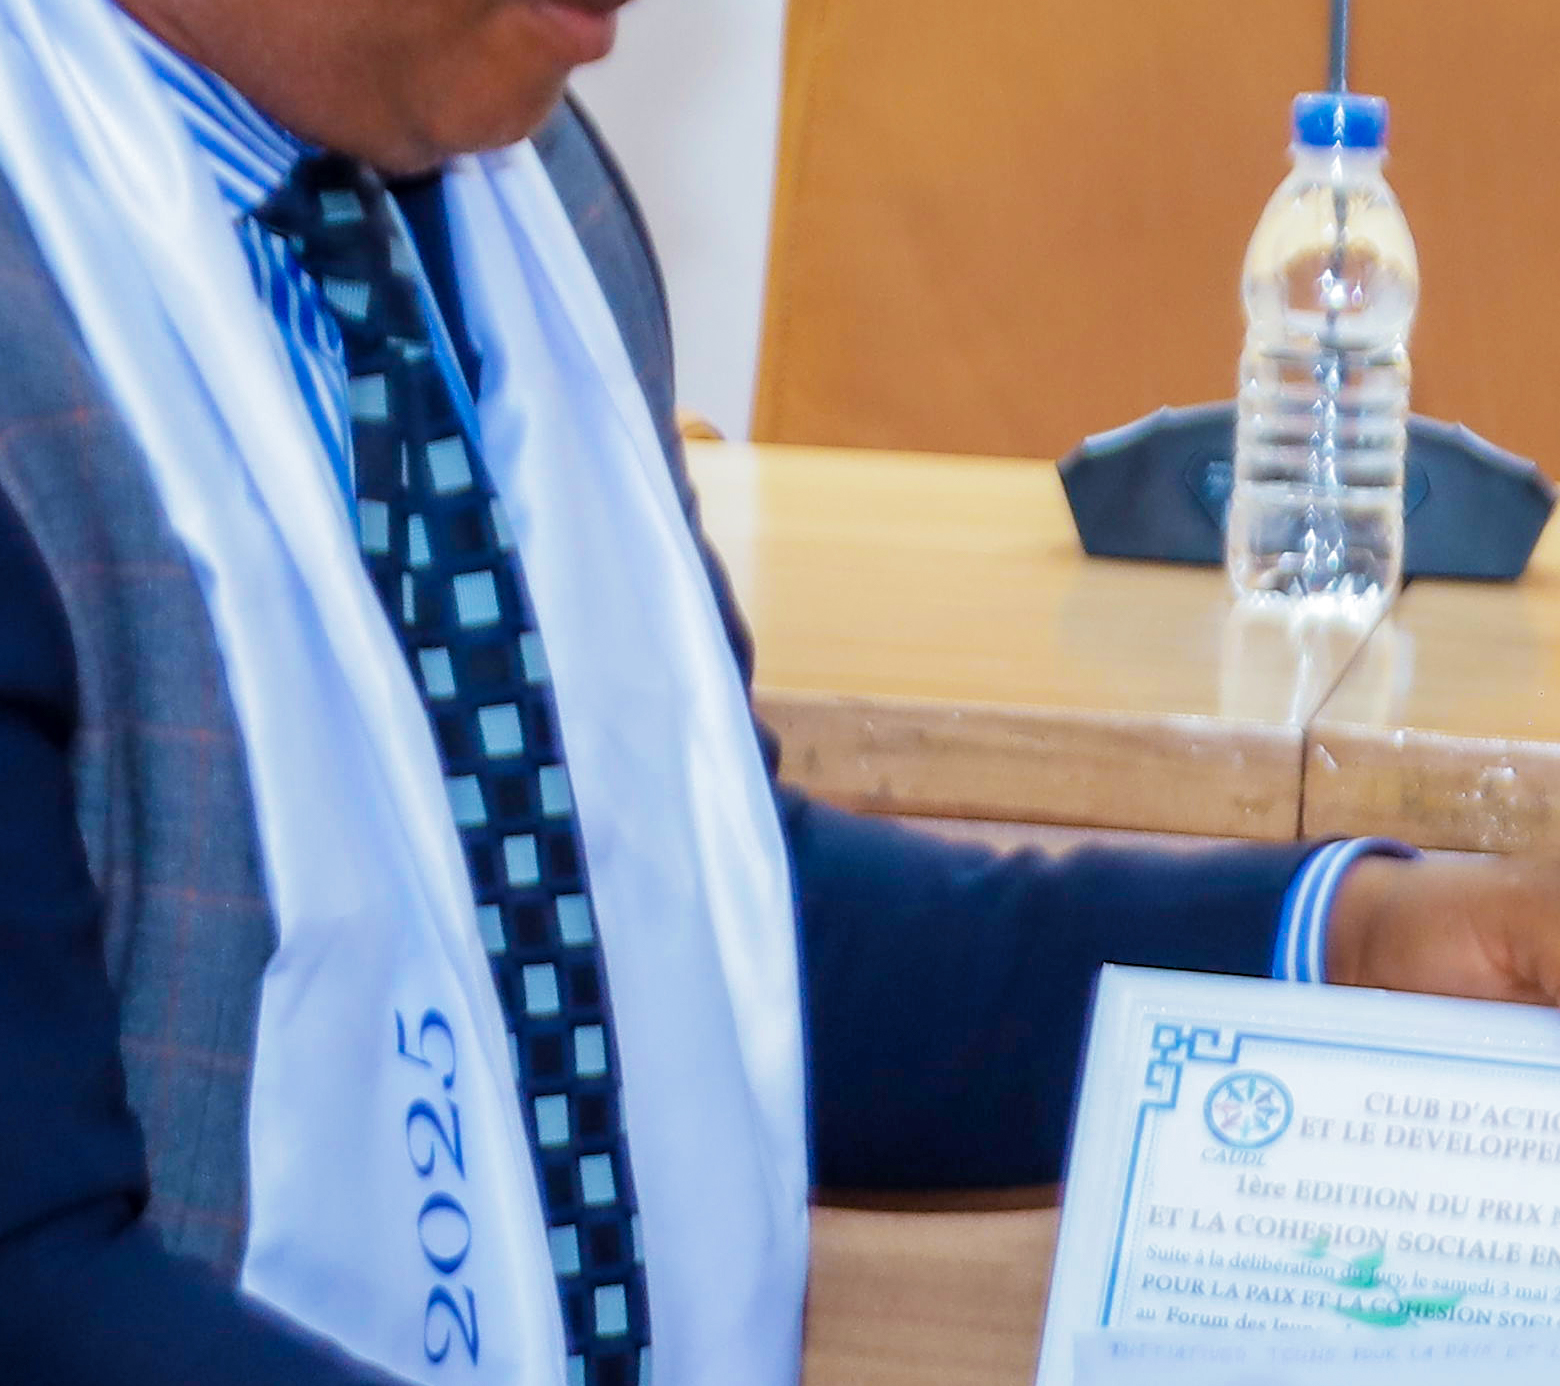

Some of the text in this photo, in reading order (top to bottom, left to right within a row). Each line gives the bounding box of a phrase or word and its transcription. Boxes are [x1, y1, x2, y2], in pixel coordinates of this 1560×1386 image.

[1299, 1116, 1333, 1140] ET
[1342, 1120, 1377, 1144] LE
[1364, 1091, 1441, 1120] CLUB
[1201, 1147, 1267, 1167] CAUDL
[395, 1007, 480, 1366] 2025
[1235, 1174, 1286, 1197] 1ère
[1295, 1178, 1419, 1213] EDITION
[1427, 1193, 1471, 1218] DU
[1480, 1198, 1544, 1227] PRIX
[1148, 1205, 1182, 1229] ET
[1191, 1209, 1226, 1234] LA
[1235, 1213, 1389, 1250] COHESION
[1397, 1231, 1521, 1265] SOCIALE
[1146, 1244, 1189, 1264] Suite
[1194, 1248, 1206, 1265] à
[1210, 1249, 1225, 1267] la
[1340, 1262, 1364, 1280] du
[1412, 1269, 1429, 1288] le
[1431, 1274, 1496, 1295] samedi
[1502, 1280, 1511, 1297] 3
[1515, 1283, 1548, 1301] mai
[1141, 1273, 1206, 1297] POUR
[1211, 1279, 1238, 1300] LA
[1245, 1283, 1294, 1305] PAIX
[1300, 1289, 1330, 1308] ET
[1336, 1291, 1364, 1312] LA
[1370, 1297, 1491, 1326] COHESION
[1165, 1306, 1228, 1326] Forum
[1235, 1312, 1267, 1330] des
